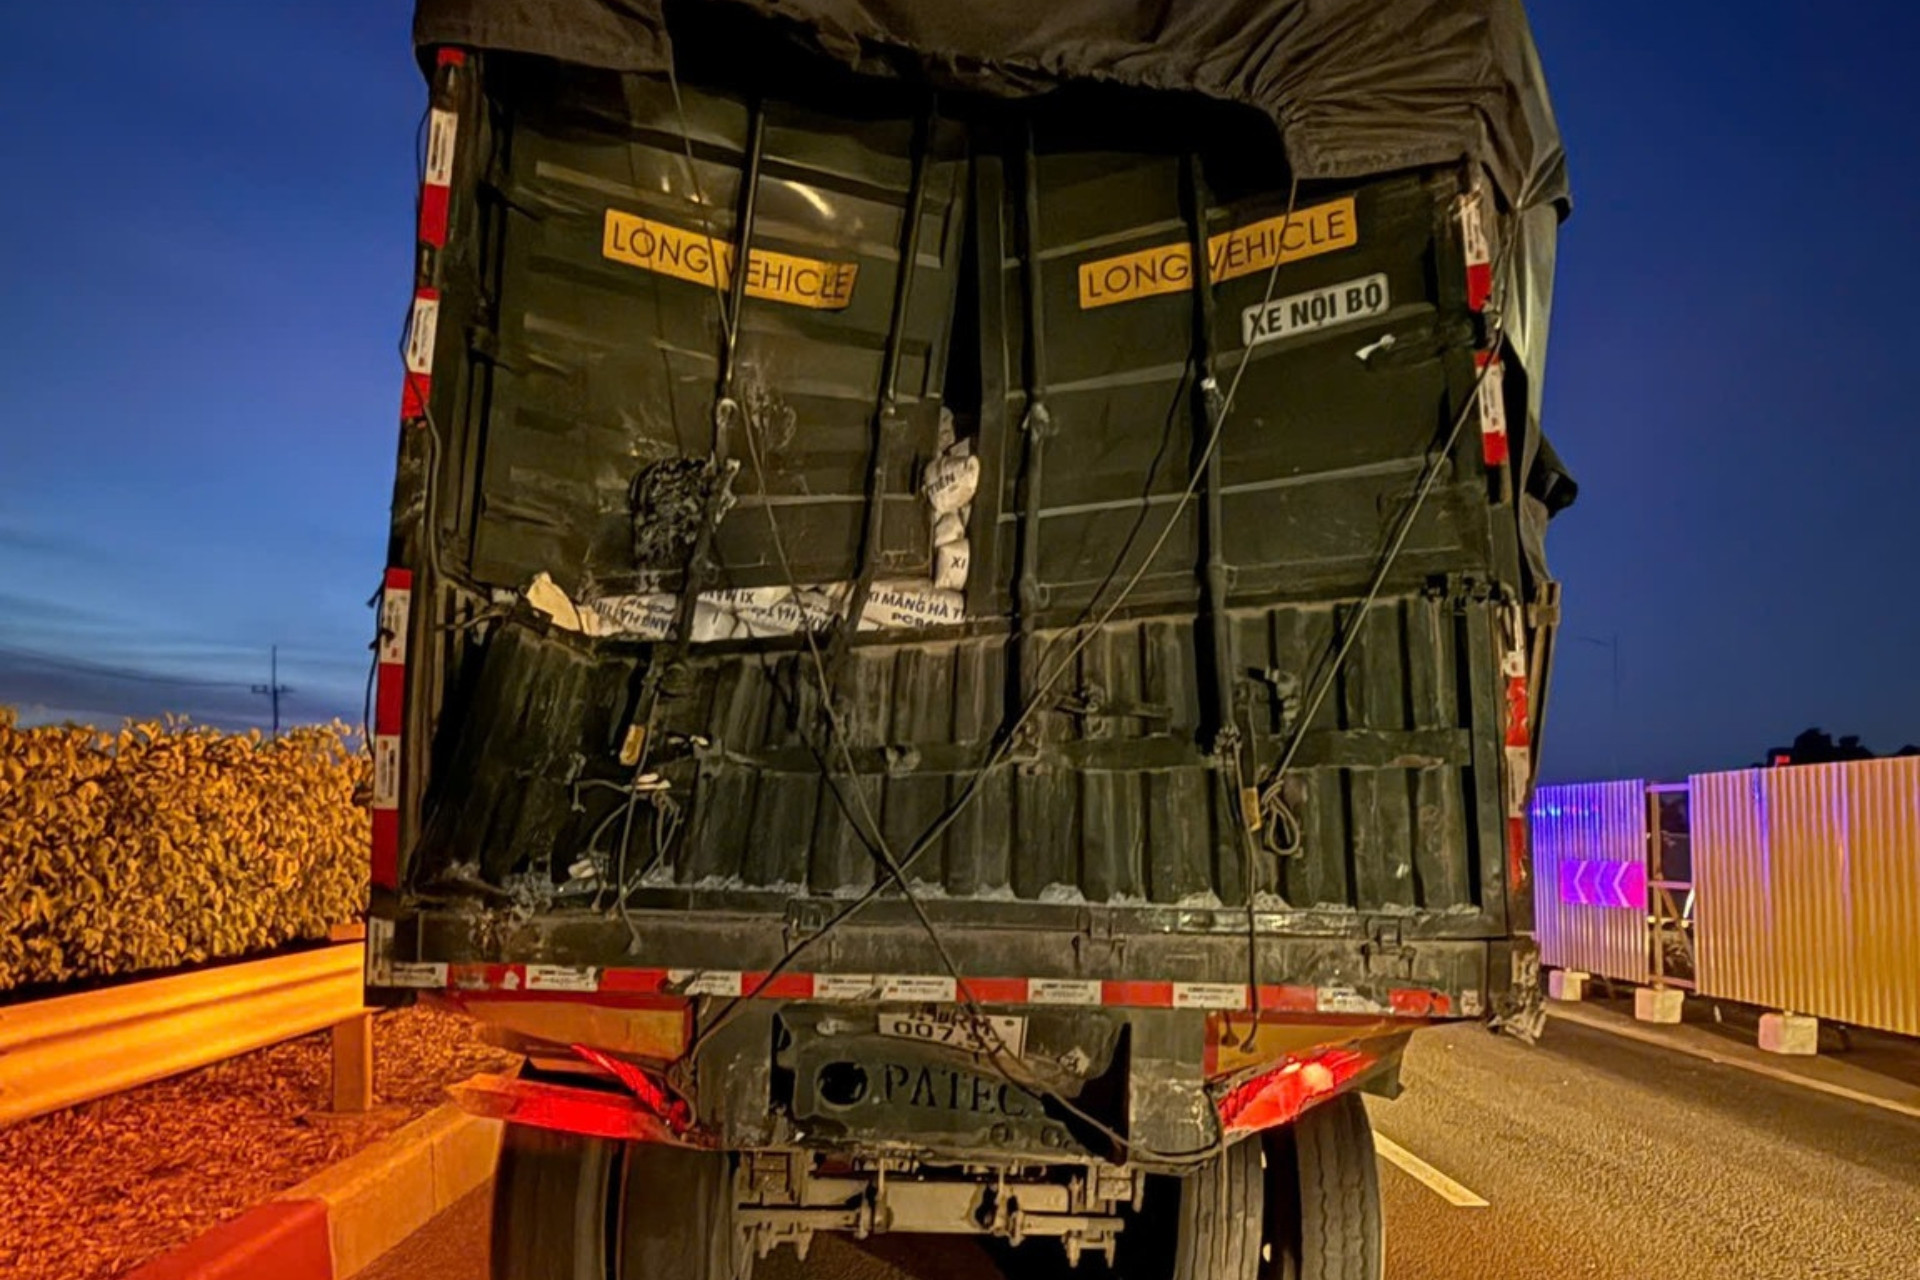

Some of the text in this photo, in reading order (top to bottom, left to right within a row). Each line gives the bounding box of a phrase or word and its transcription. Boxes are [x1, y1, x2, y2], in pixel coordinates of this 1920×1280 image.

[613, 220, 709, 274] LONG
[1087, 254, 1189, 298] LONG
[1249, 278, 1383, 336] XE NỘI BỘ
